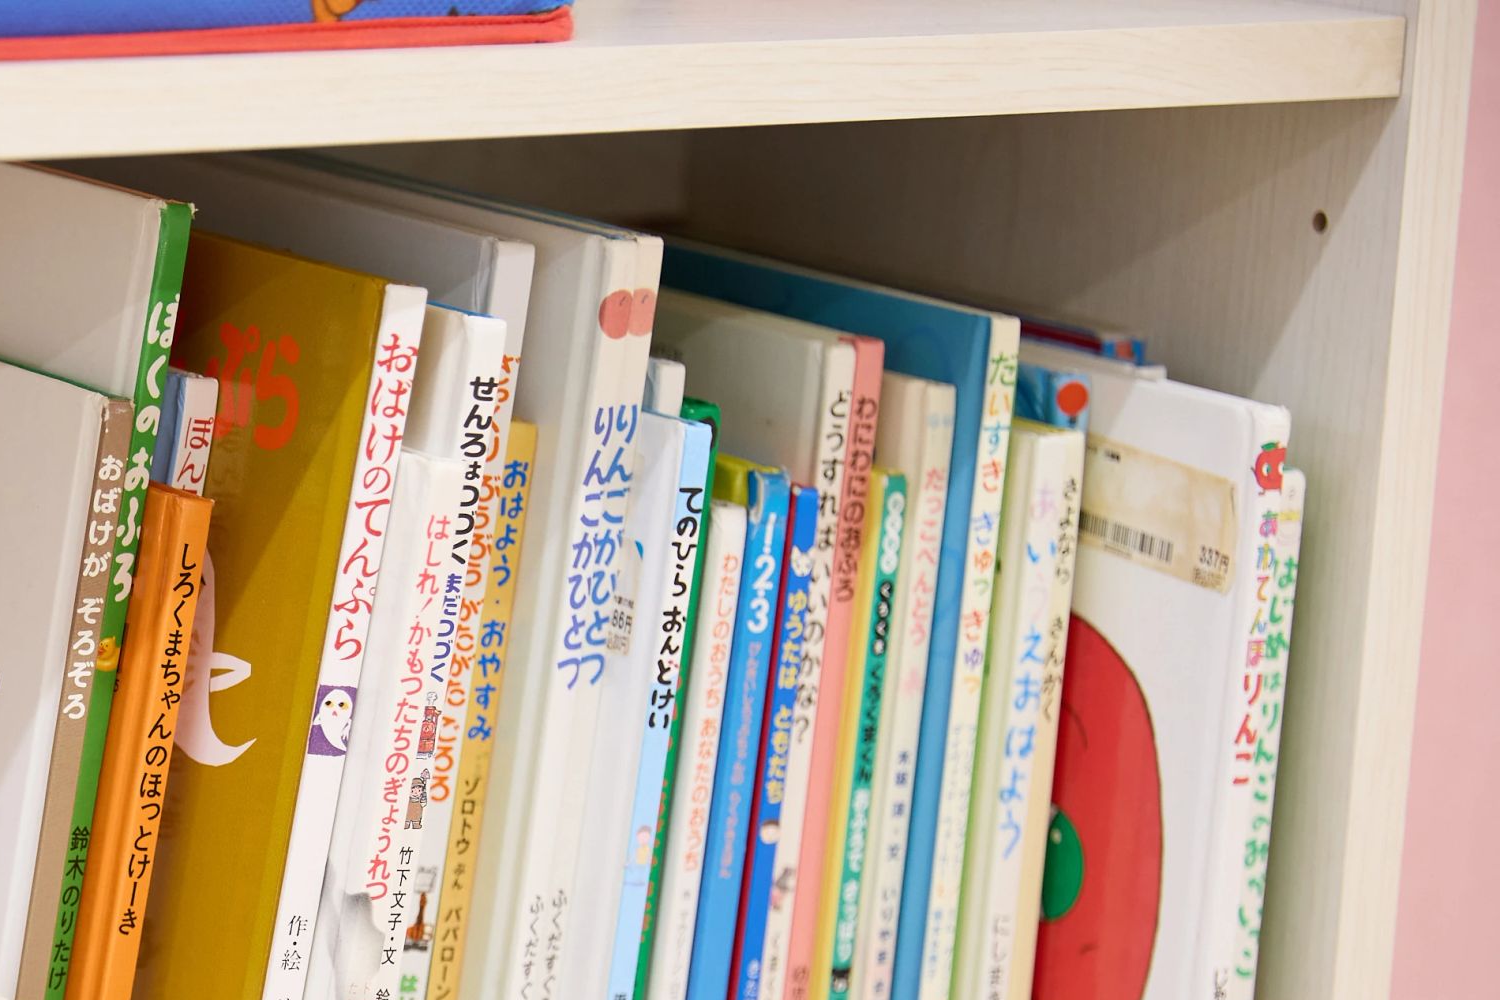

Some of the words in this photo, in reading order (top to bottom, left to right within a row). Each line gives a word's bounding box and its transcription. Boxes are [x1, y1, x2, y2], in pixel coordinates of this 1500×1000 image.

[81, 454, 127, 578] おばけが
[176, 416, 215, 496] ぽん
[333, 333, 419, 661] おばけのてんぷら
[670, 486, 704, 598] てのひら
[62, 597, 105, 721] ぞろぞろ
[647, 608, 687, 730] おんどけい
[117, 543, 198, 936] しろくまちゃんのほっとけーき
[47, 825, 91, 991] 鈴木のりたけ
[280, 914, 309, 972] 作・絵
[382, 846, 415, 966] 竹下文子・文
